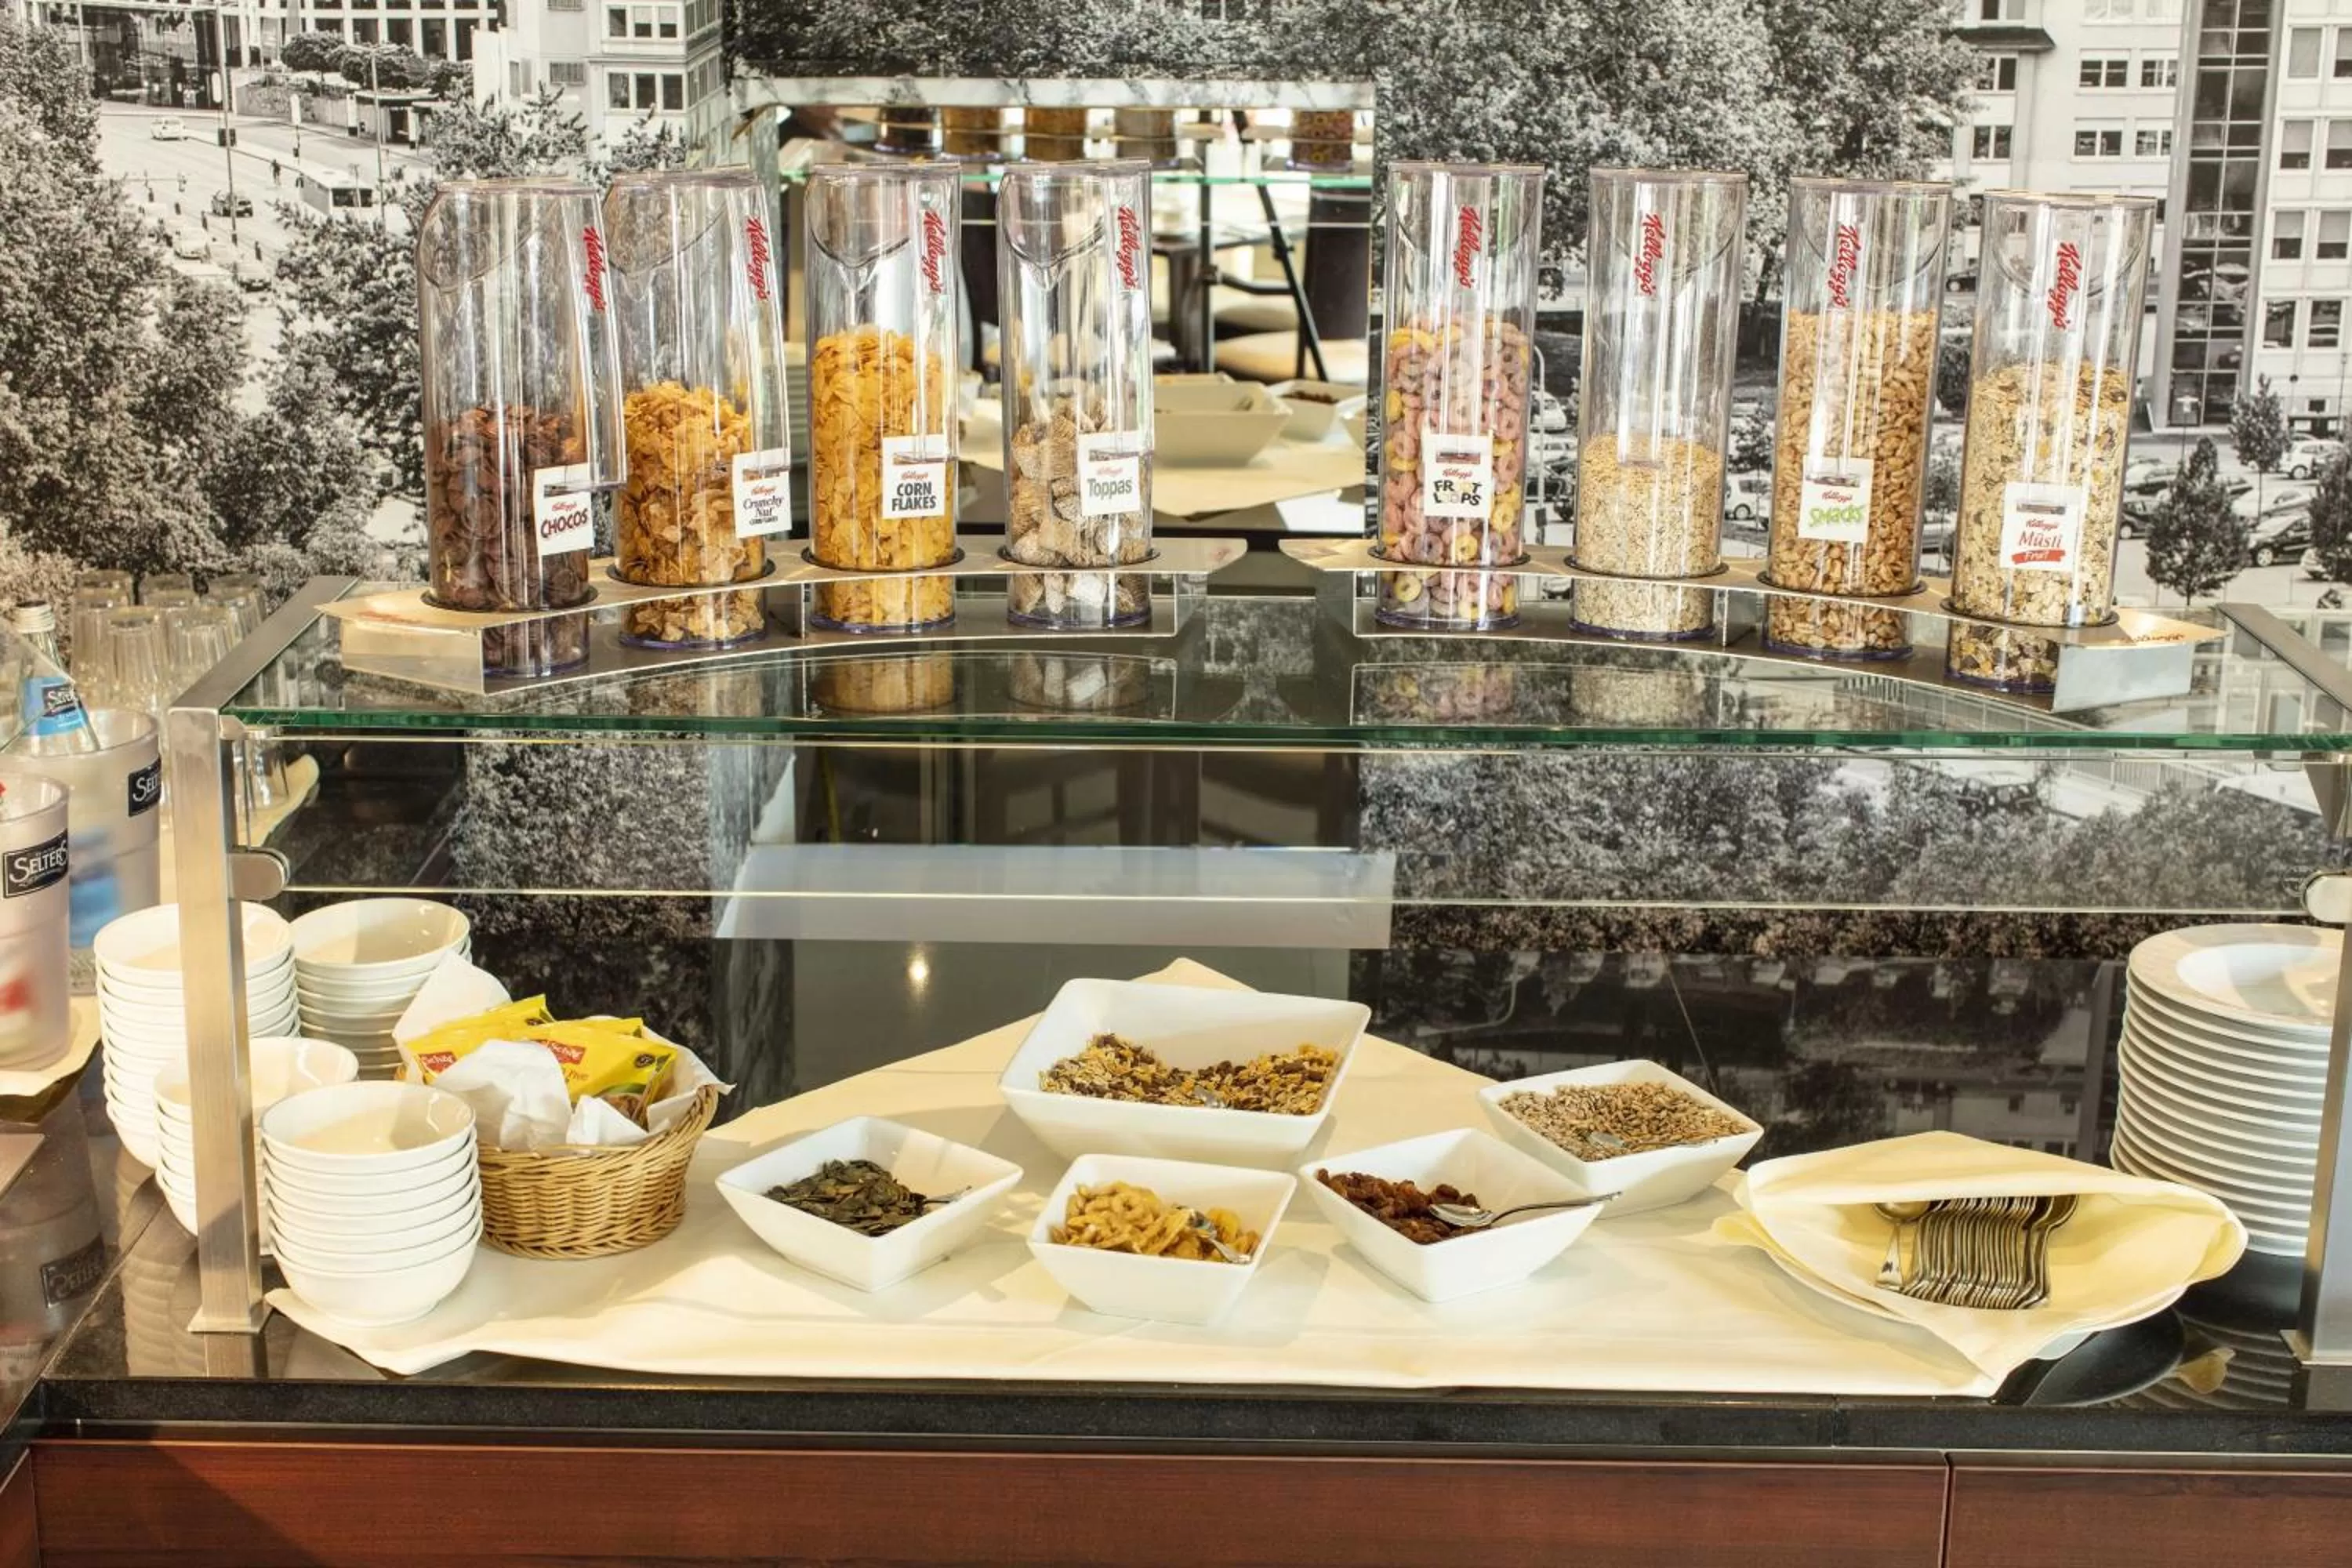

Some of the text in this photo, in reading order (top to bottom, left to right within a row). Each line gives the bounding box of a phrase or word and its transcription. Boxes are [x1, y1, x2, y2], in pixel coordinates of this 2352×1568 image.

[583, 225, 606, 314] Kellogg's
[746, 216, 771, 301] Kellogg's
[919, 209, 946, 294] Kellogg's
[1117, 207, 1140, 289] Kellogg's
[1454, 207, 1483, 288] Kellogg's
[1635, 212, 1667, 297] Kellogg's
[1826, 224, 1861, 308] Kellogg's
[2048, 242, 2081, 330] Kellogg's
[742, 495, 784, 510] Crunchy
[755, 508, 773, 518] Nut
[891, 495, 937, 512] FLAKES
[896, 481, 932, 496] CORN
[1087, 477, 1133, 501] Toppas
[540, 508, 588, 539] CHOCOS
[2017, 531, 2064, 548] Müsli
[9, 840, 67, 884] SELTERS
